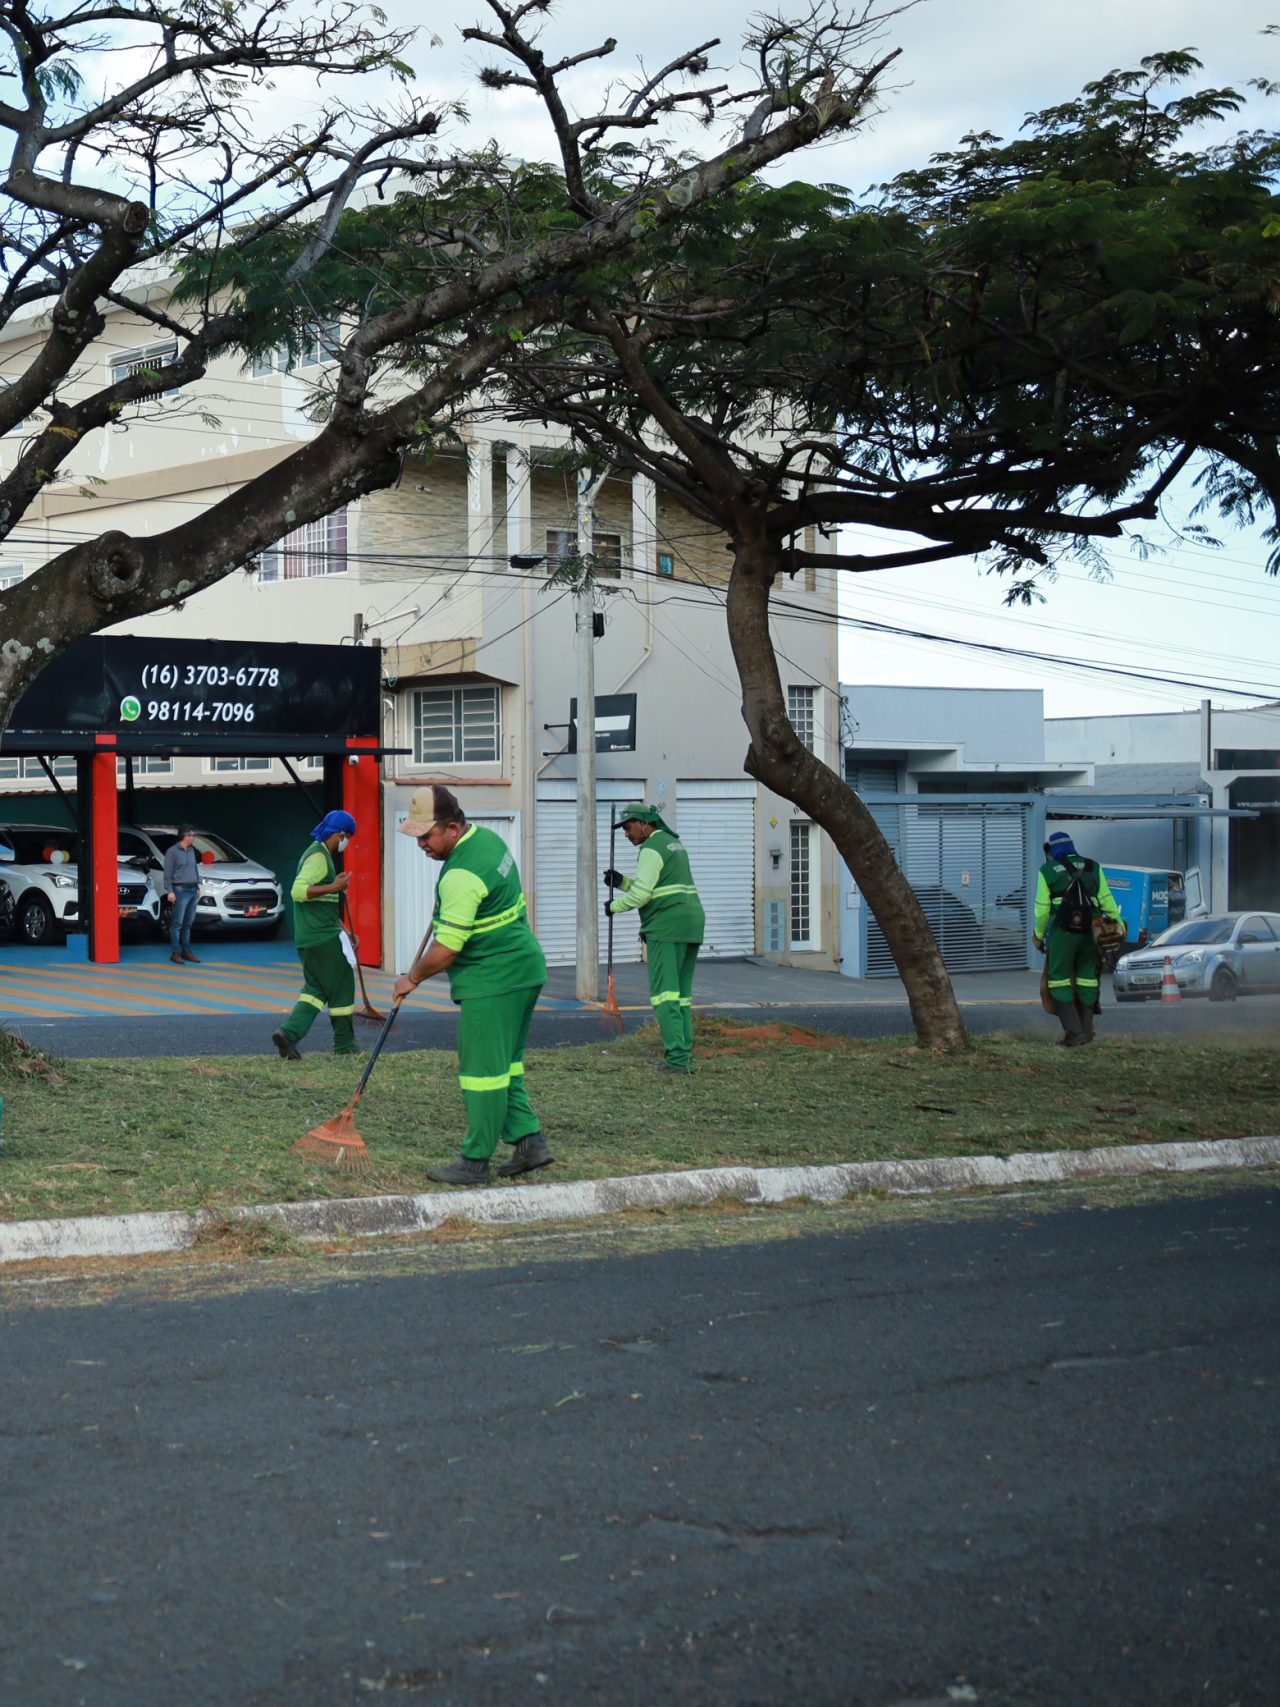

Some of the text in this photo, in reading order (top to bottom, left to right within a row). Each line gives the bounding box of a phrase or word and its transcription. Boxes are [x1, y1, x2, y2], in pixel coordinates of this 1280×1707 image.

[141, 664, 280, 689] (16) 3703-6778
[147, 701, 256, 723] 98114-7096
